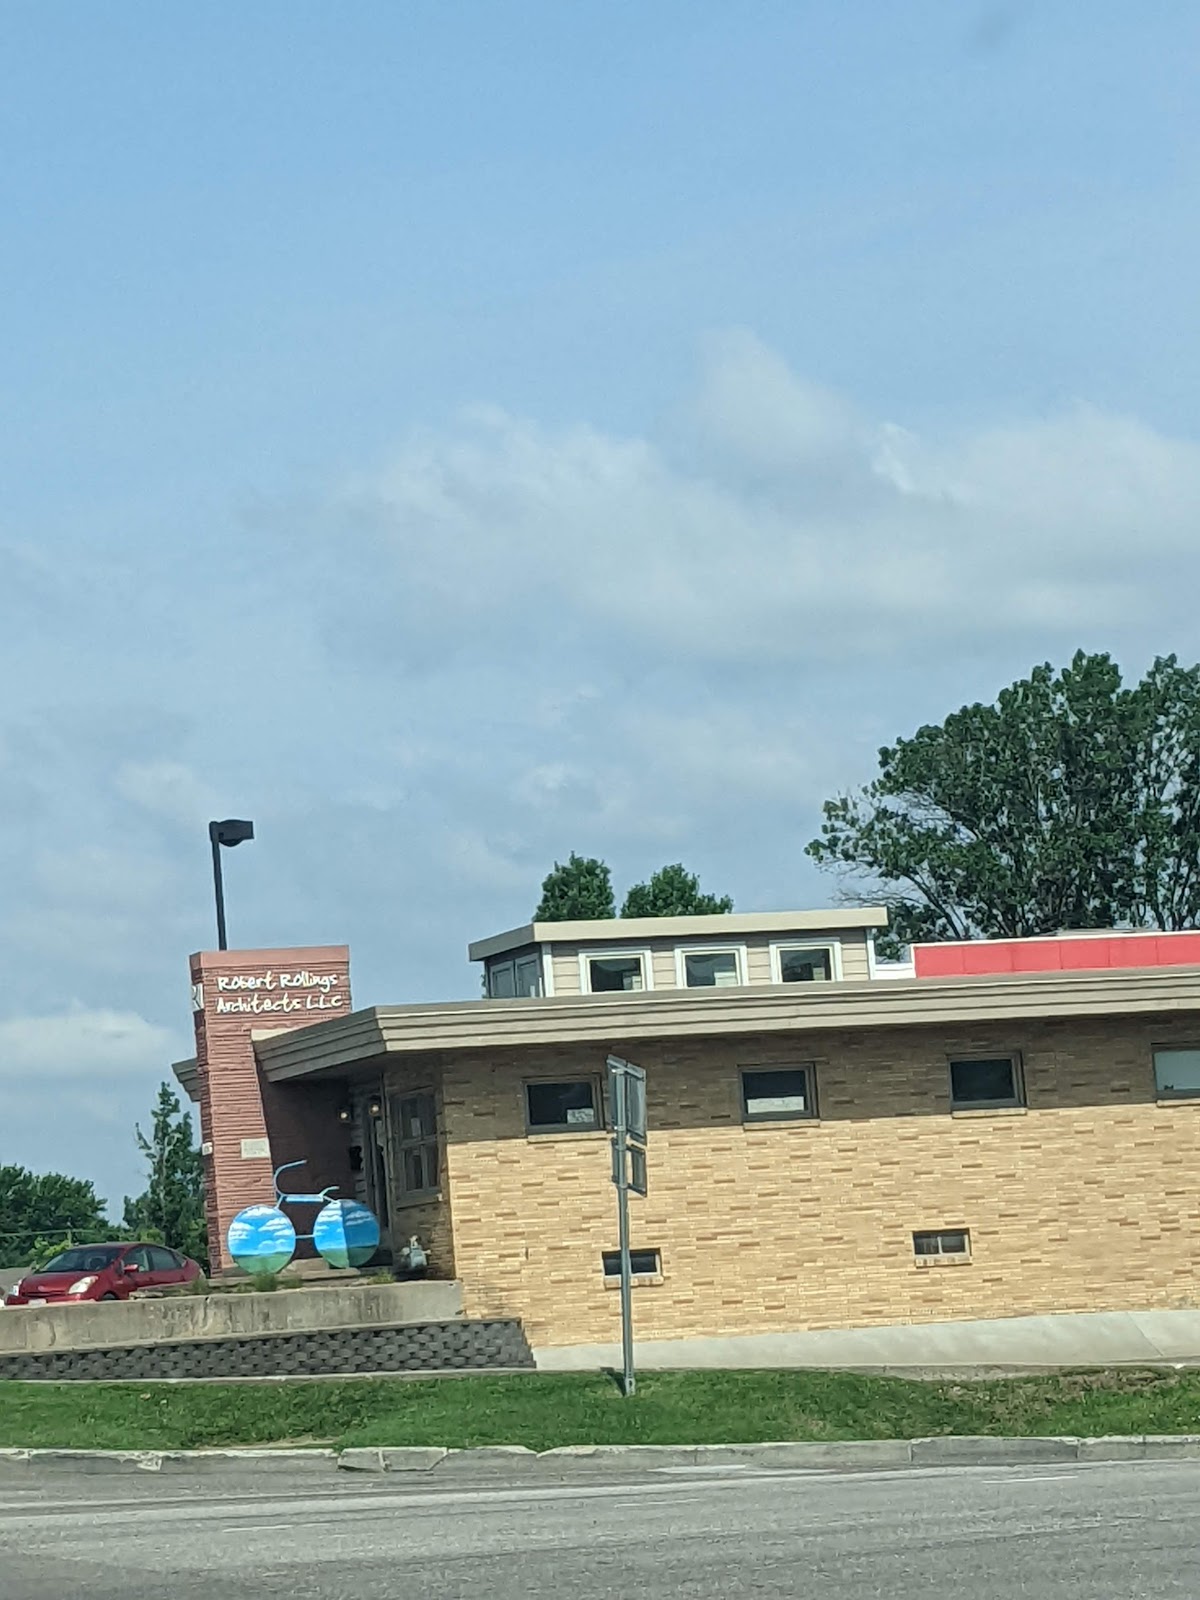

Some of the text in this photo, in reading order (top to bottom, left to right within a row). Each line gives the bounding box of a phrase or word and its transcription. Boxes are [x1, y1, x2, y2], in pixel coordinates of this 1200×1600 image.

[217, 971, 338, 993] Robert Rollings
[216, 993, 301, 1013] Architects
[306, 995, 343, 1009] LLC
